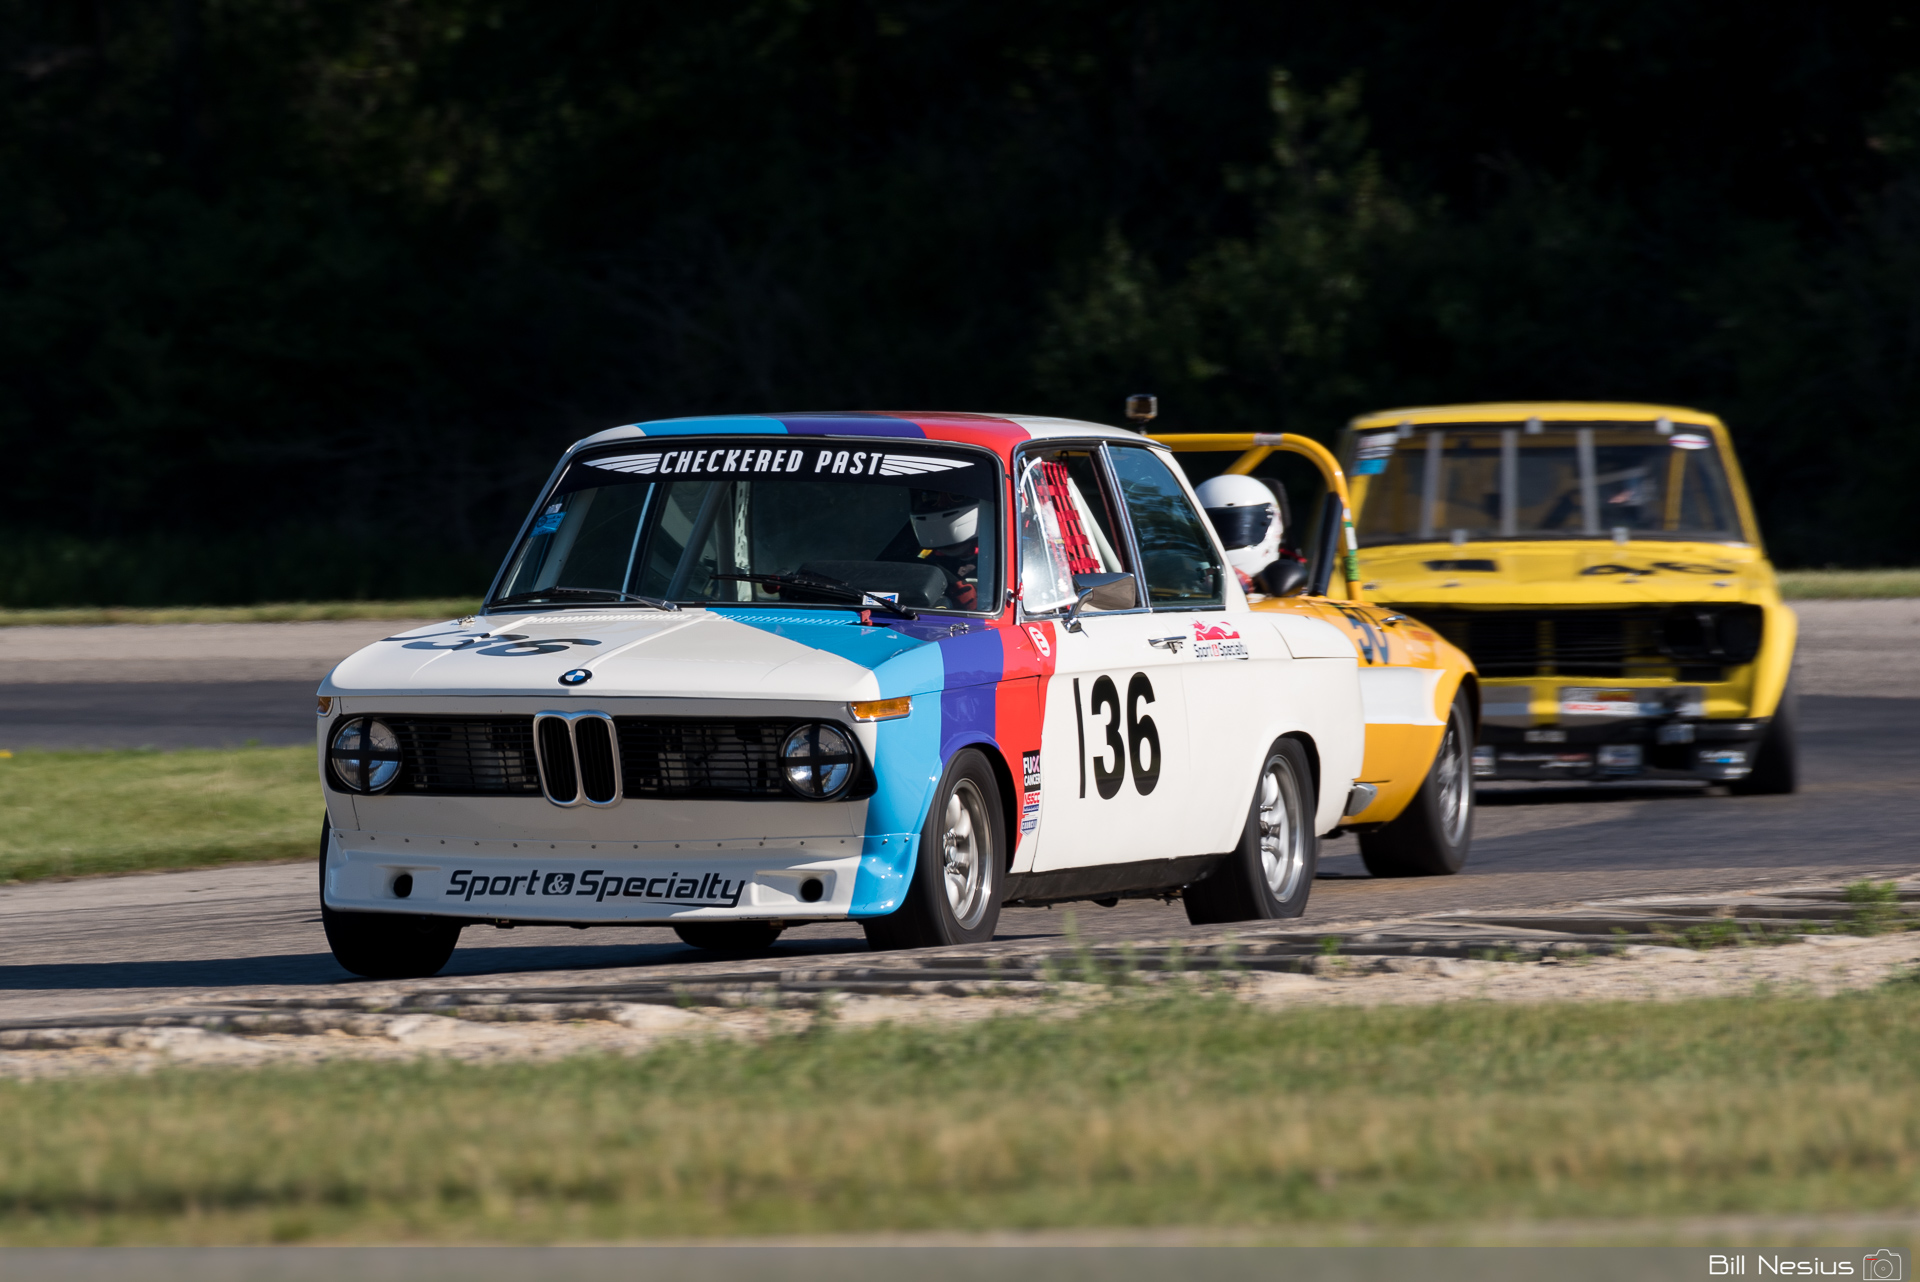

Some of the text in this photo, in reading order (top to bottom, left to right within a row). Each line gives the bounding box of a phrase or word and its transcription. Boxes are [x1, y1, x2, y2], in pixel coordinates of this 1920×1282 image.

[660, 450, 882, 475] CHECKERED PAST
[1073, 671, 1161, 800] 136
